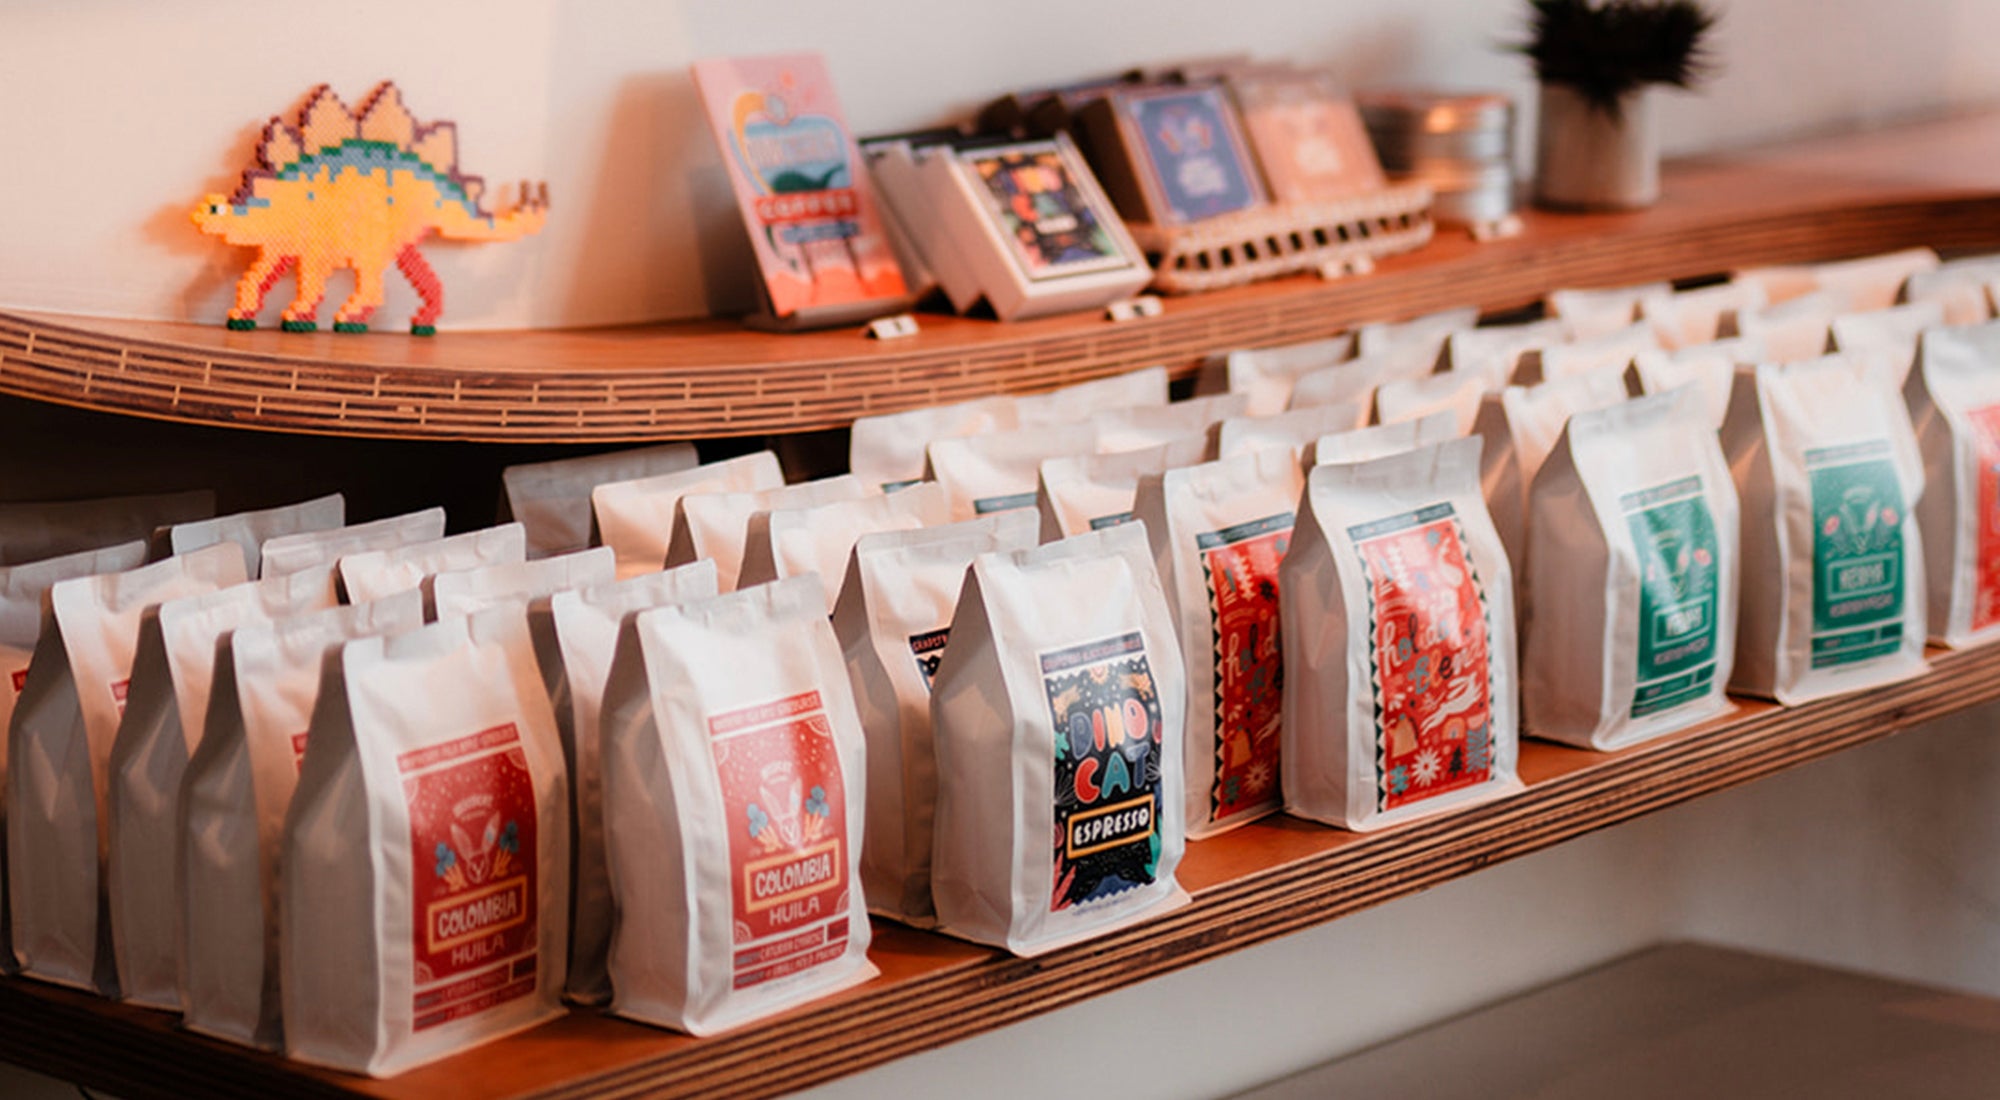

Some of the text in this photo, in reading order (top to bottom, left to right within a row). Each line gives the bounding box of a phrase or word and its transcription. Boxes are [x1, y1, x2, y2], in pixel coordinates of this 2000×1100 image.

[1380, 602, 1461, 676] holida
[1070, 698, 1149, 760] DINO
[1074, 741, 1150, 803] CAT
[1073, 807, 1150, 846] ESPRESSO
[755, 853, 831, 898] COLOMBIA
[438, 890, 517, 938] COLOMBIA
[769, 896, 820, 926] HUILA
[451, 933, 506, 966] HUILA
